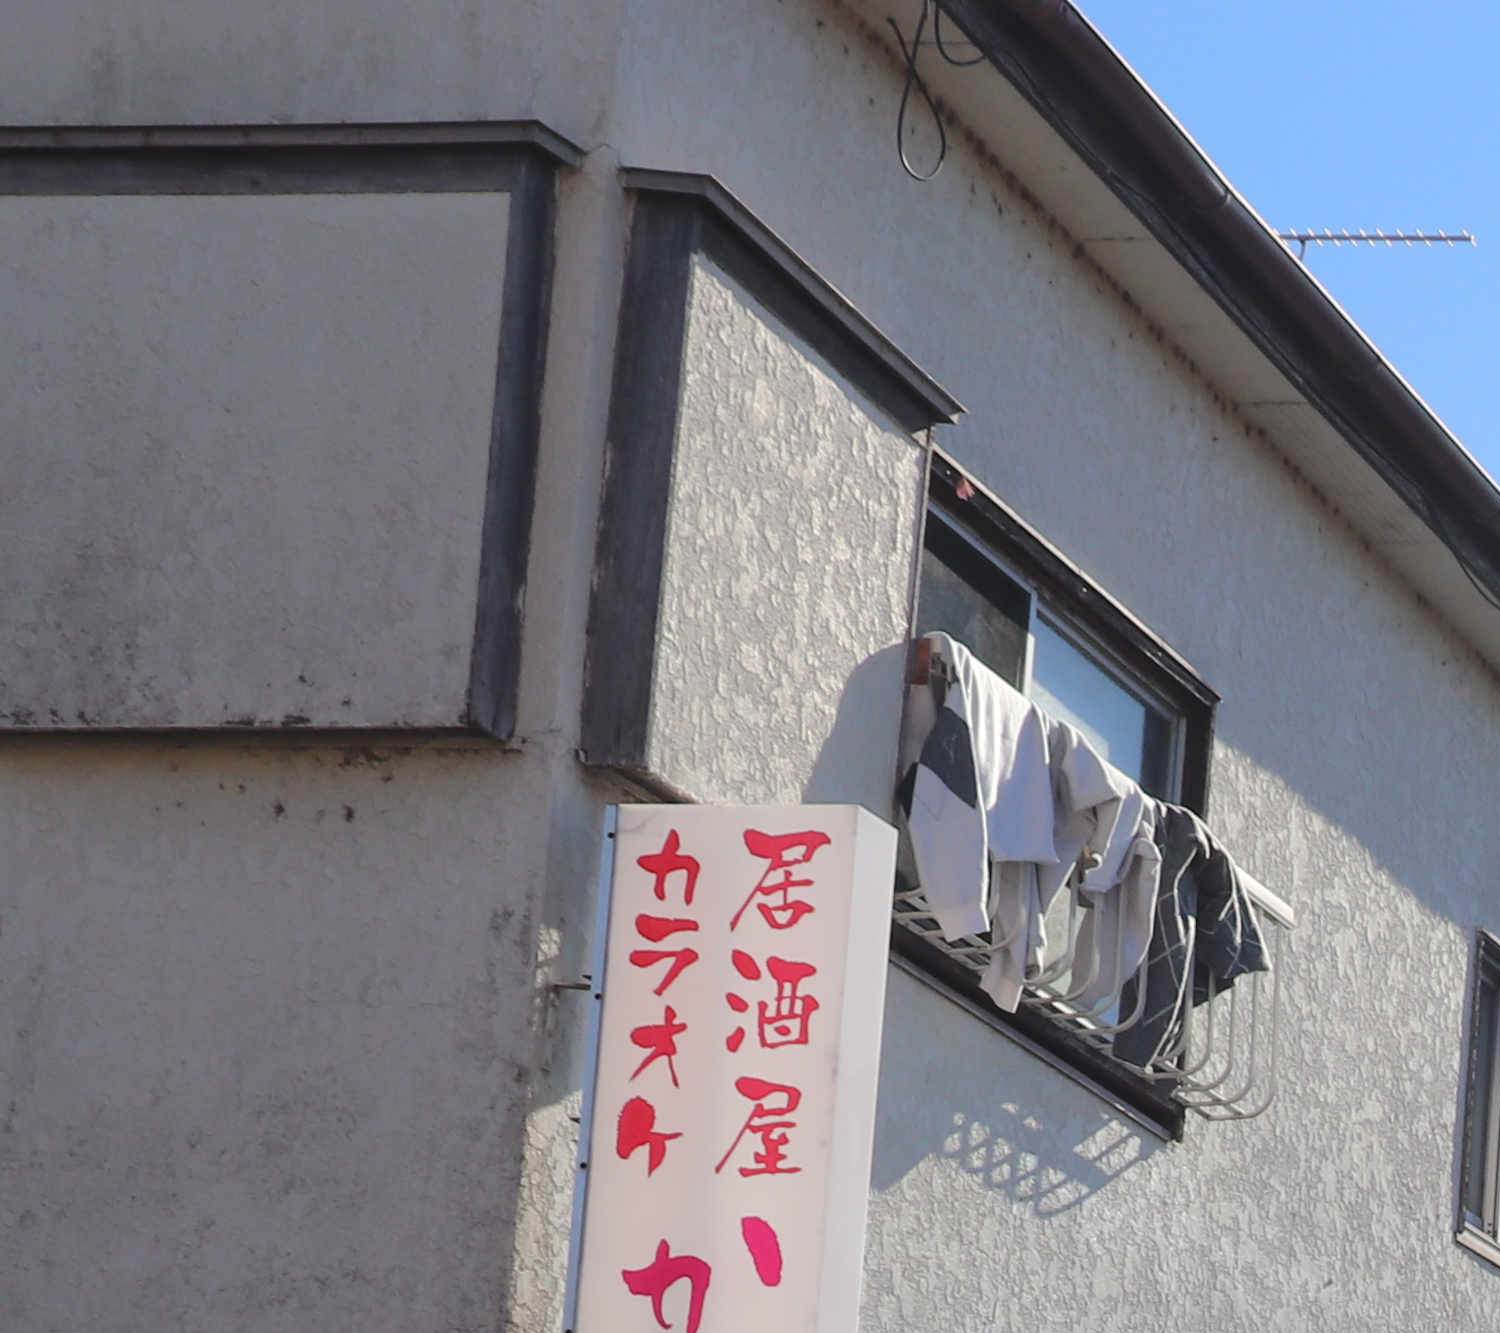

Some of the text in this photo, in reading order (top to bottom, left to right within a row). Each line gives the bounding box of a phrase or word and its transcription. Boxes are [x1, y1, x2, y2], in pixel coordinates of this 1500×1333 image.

[616, 828, 701, 1179] カラオケ
[715, 827, 831, 1177] 居酒屋
